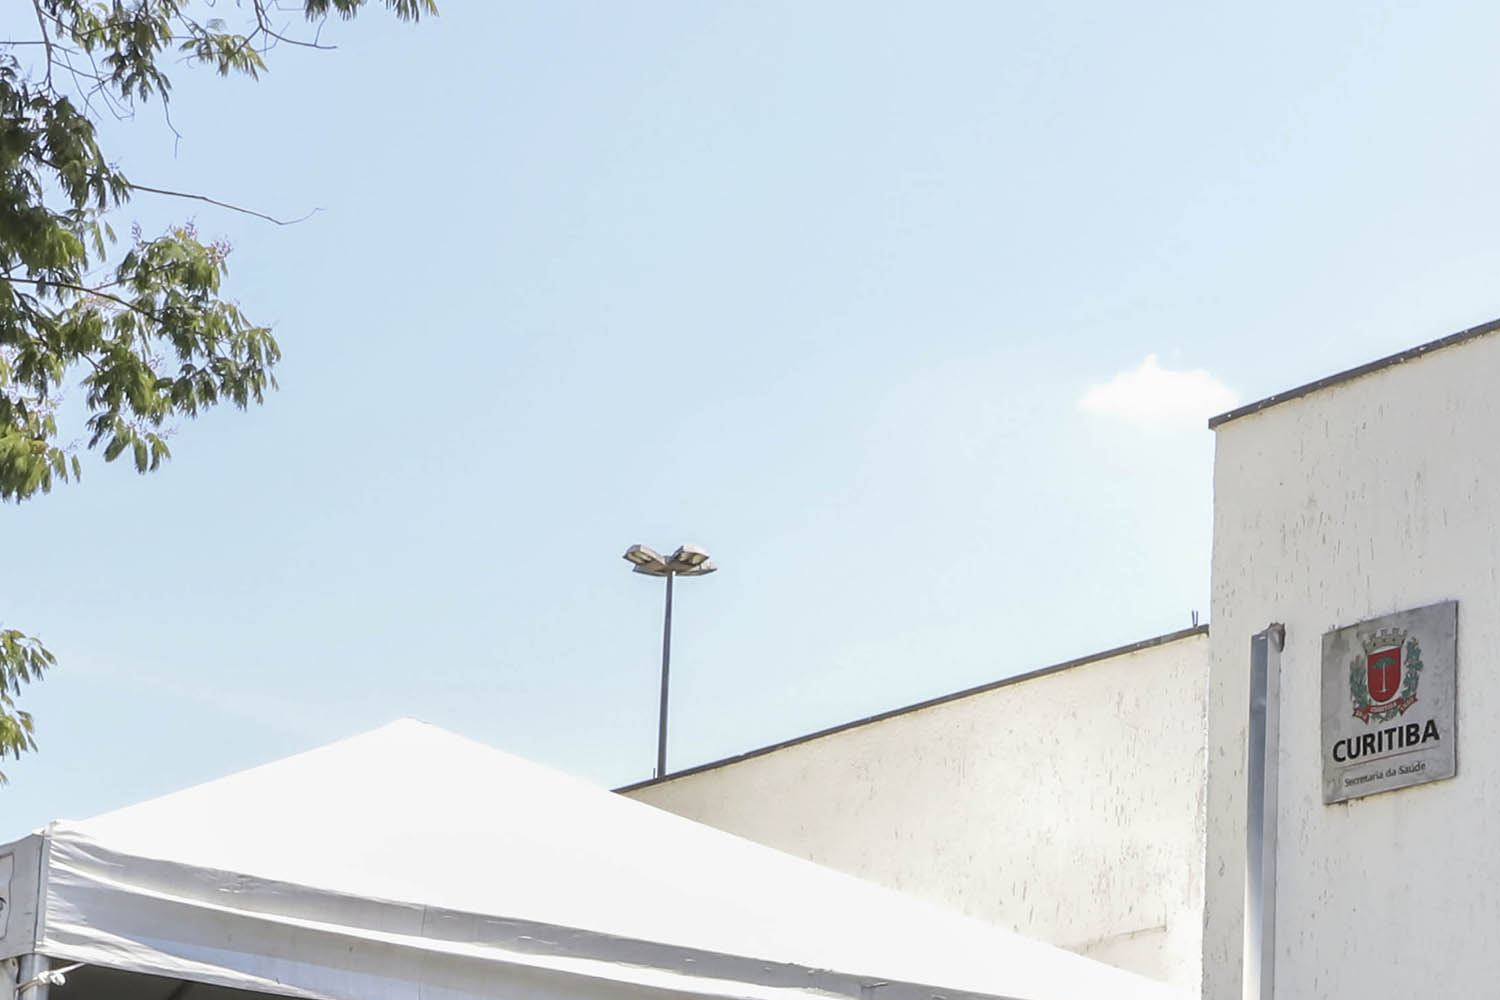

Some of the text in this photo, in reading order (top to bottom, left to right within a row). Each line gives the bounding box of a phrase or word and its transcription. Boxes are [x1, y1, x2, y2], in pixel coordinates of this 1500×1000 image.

[1332, 719, 1440, 763] CURITIBA
[1344, 769, 1384, 787] Secretaria
[1385, 768, 1397, 778] da
